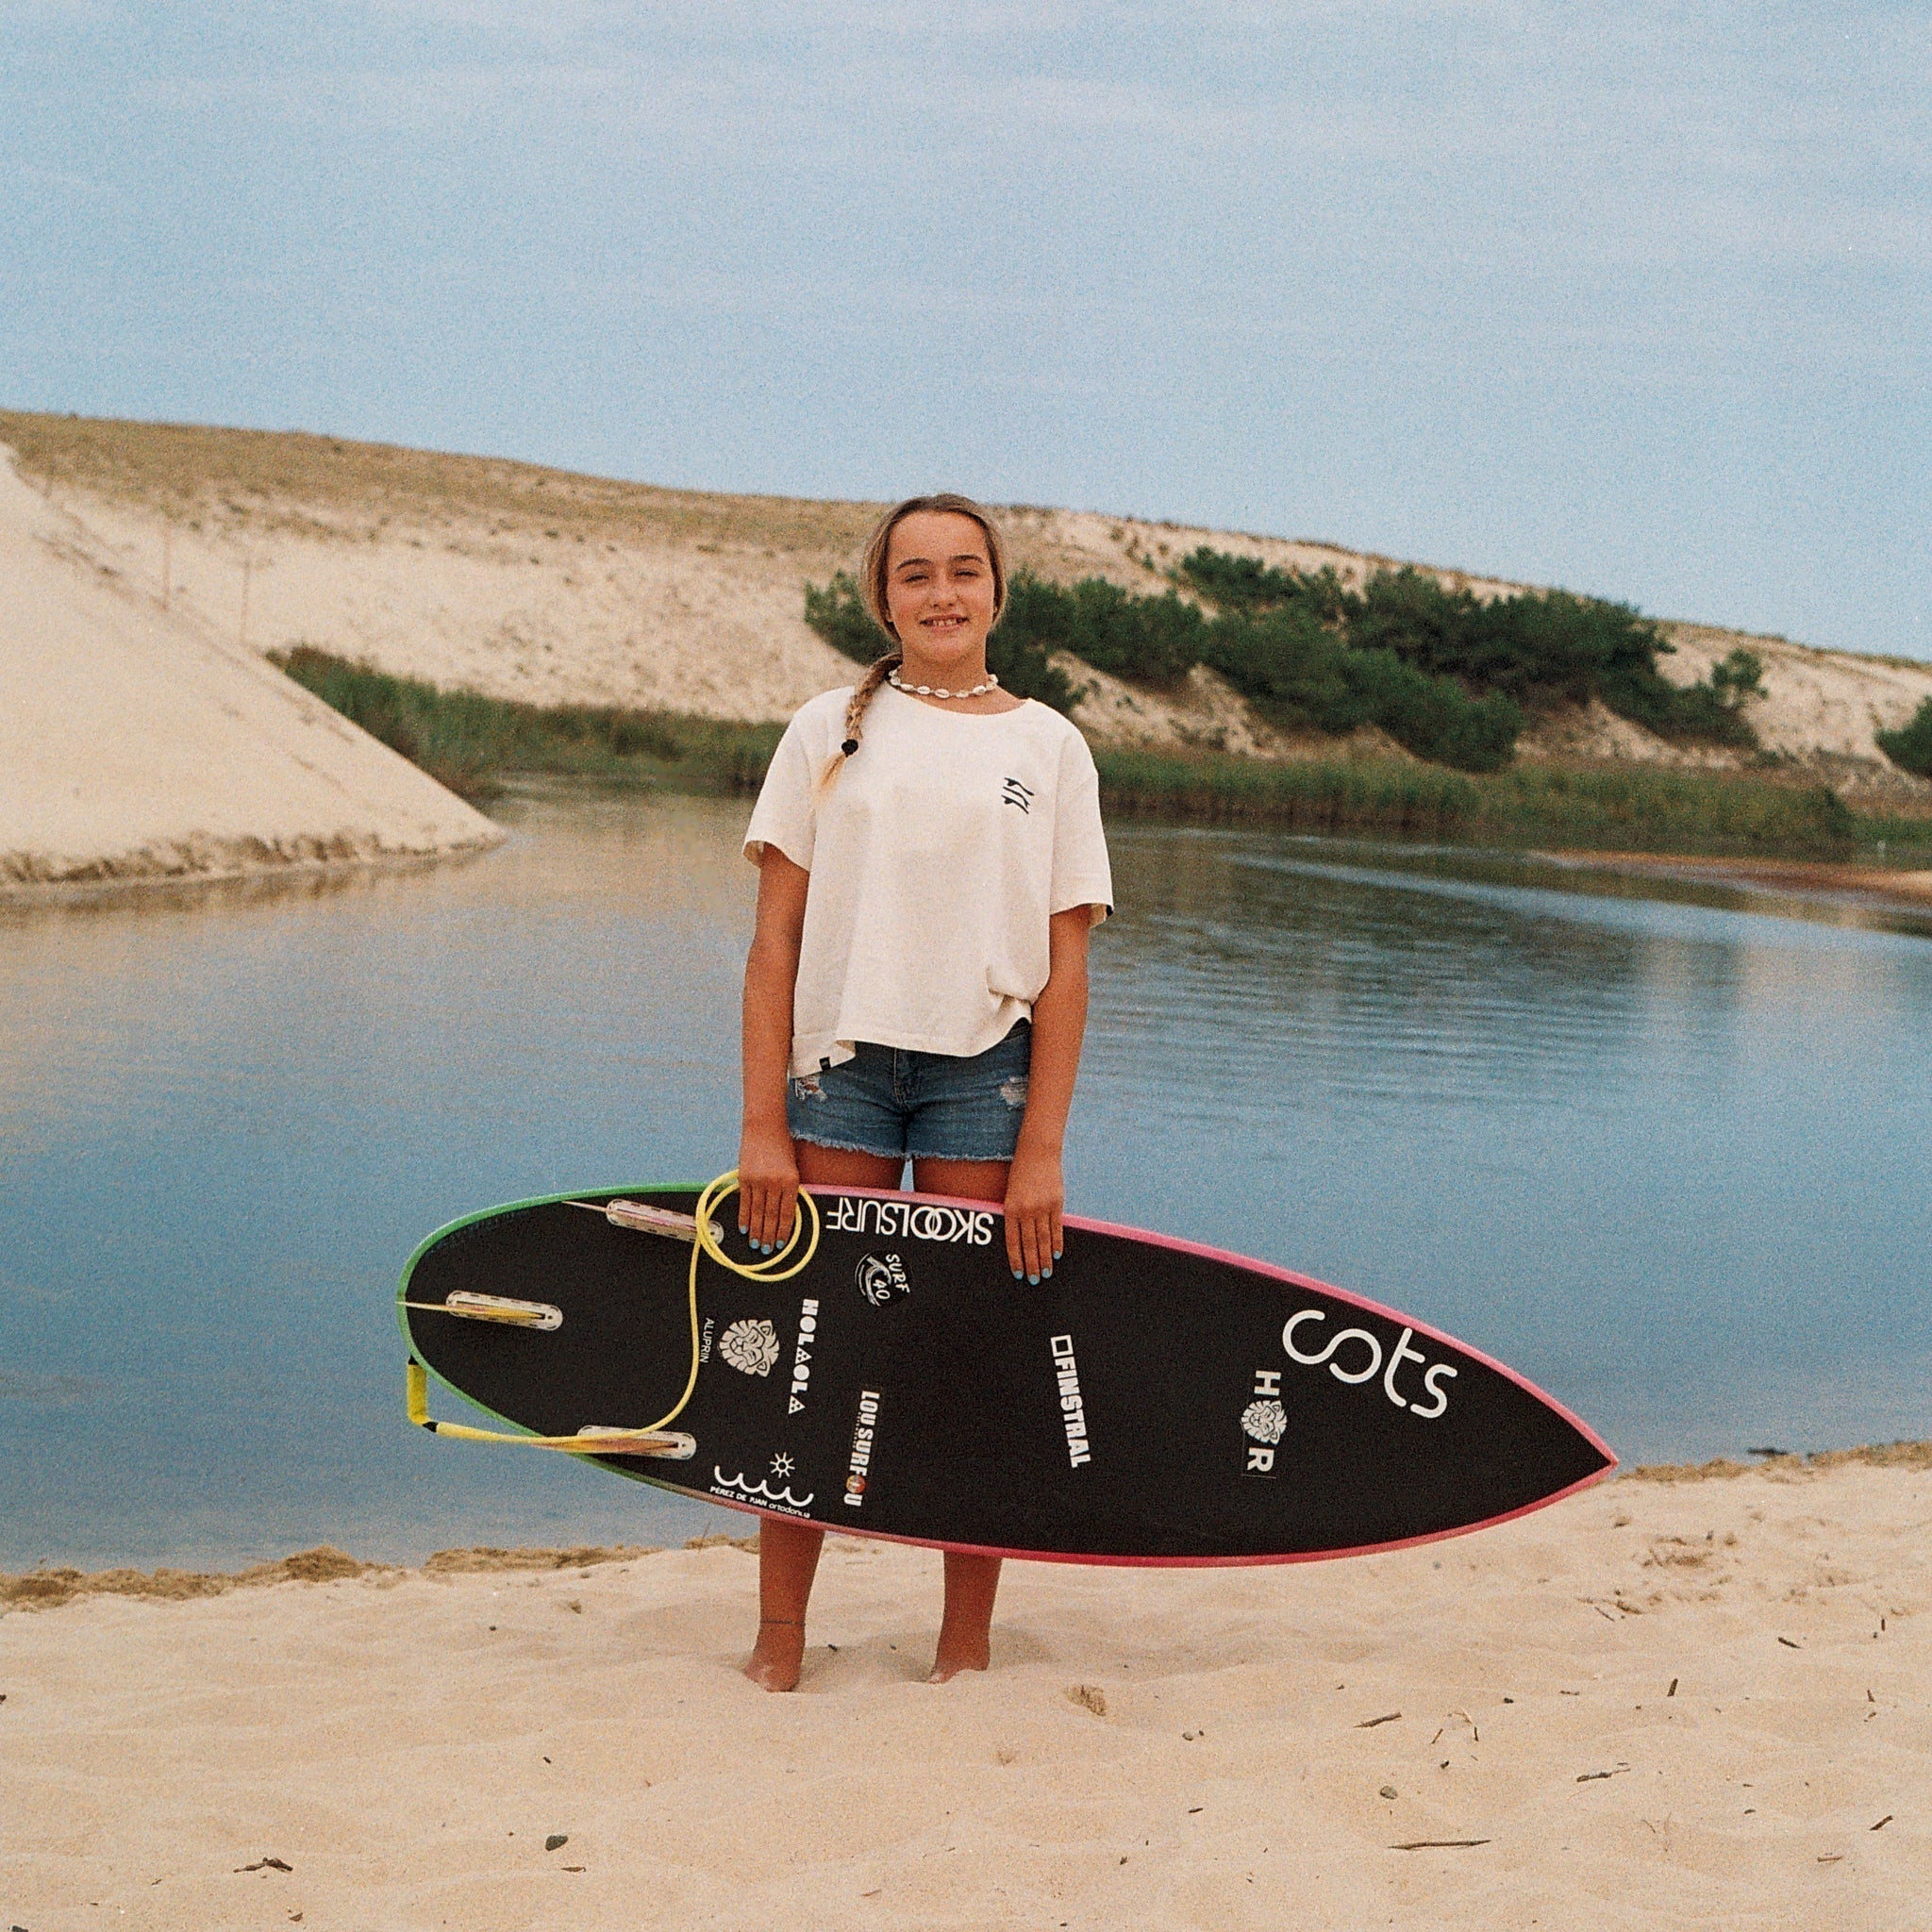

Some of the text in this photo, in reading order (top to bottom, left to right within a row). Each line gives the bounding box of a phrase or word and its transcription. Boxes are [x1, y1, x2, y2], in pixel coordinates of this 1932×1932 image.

[825, 1197, 994, 1245] SKOOLSURF
[873, 1279, 891, 1299] 40
[885, 1254, 910, 1293] SURF
[699, 1317, 715, 1363] ALUPRIN
[1054, 1356, 1091, 1469] FINSTRAL
[709, 1485, 736, 1499] PÉREZ
[736, 1492, 747, 1502] DE
